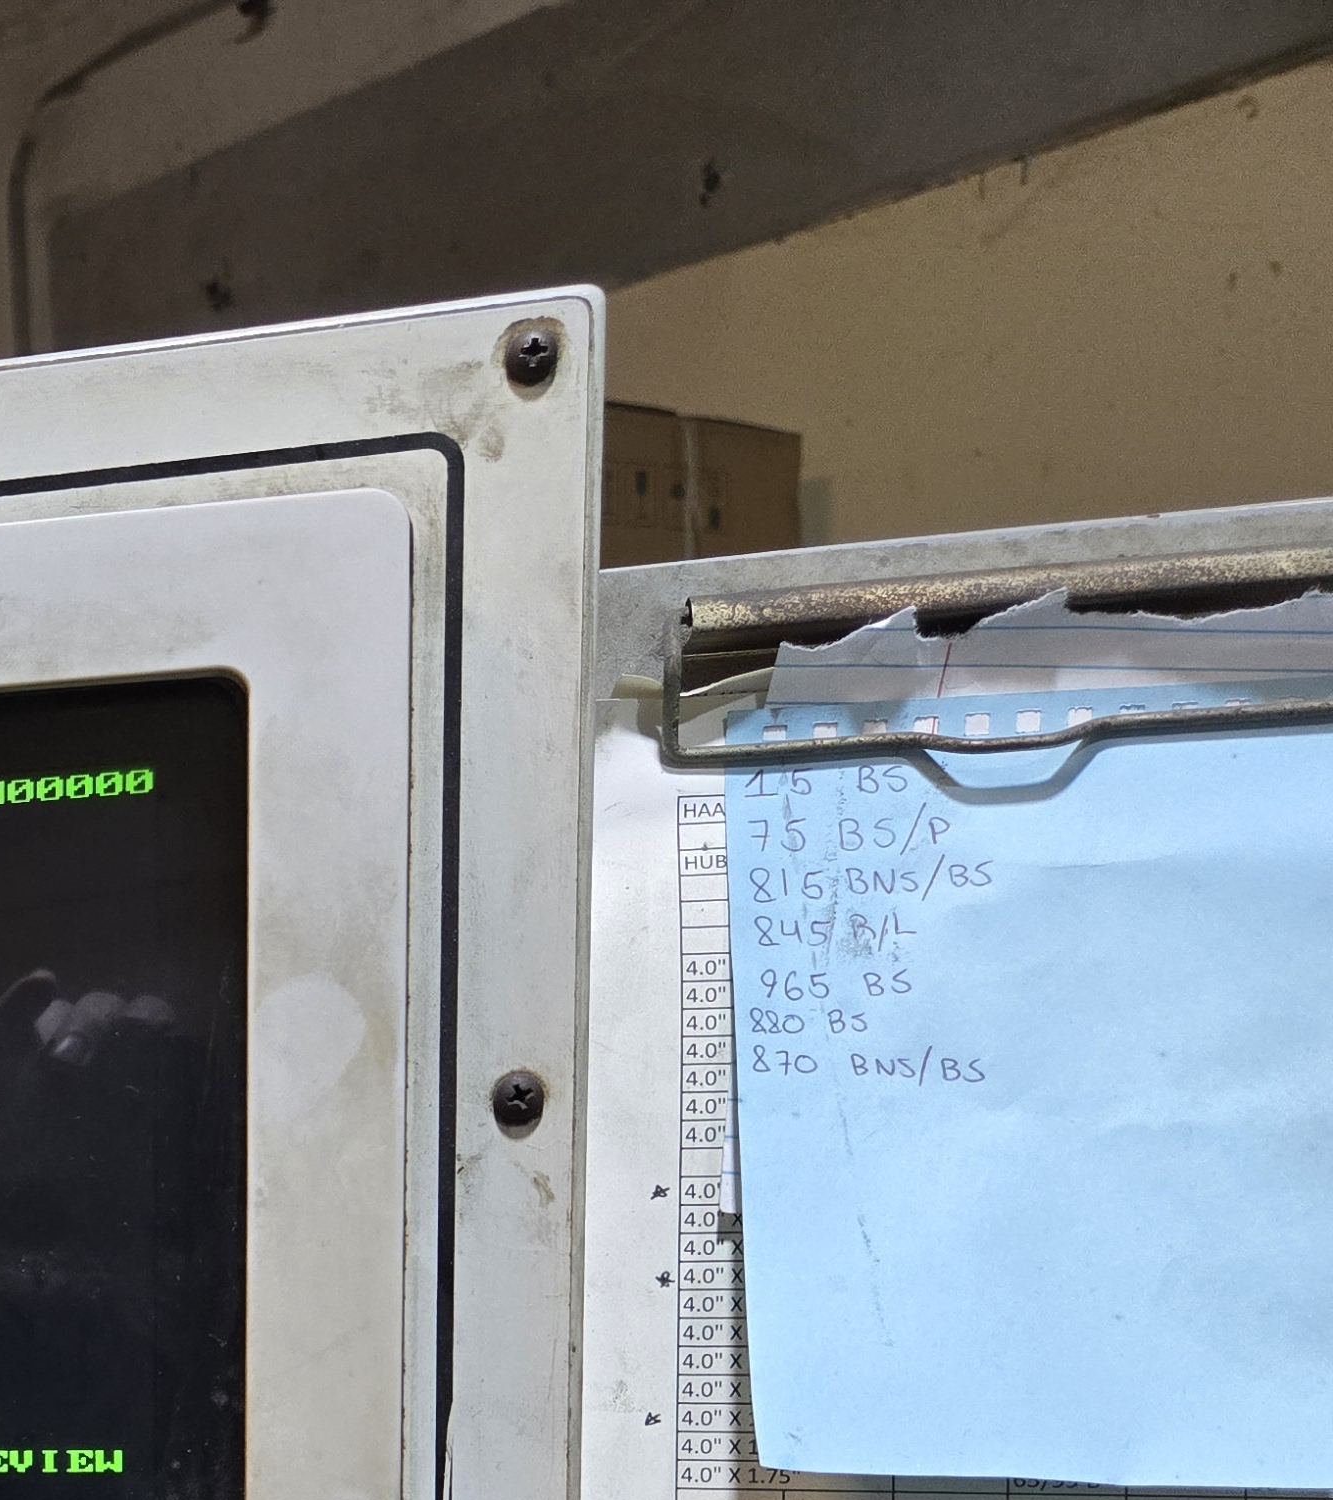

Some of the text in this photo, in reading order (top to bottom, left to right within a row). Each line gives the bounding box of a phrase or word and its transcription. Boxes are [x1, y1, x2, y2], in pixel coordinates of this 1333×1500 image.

[857, 765, 908, 792] BS
[749, 818, 806, 852] 75
[684, 854, 727, 869] HUB
[749, 867, 824, 901] 815
[754, 916, 831, 946] 845
[686, 959, 726, 976] 4.0"
[686, 986, 726, 1003] 4.0"
[760, 969, 912, 1001] 965 BS
[749, 1008, 868, 1034] 880 BS
[752, 1045, 817, 1076] 870
[683, 1268, 743, 1284] 4.0" X
[682, 1410, 742, 1427] 4.0" X
[681, 1467, 722, 1483] 4.0"
[728, 1468, 741, 1483] X
